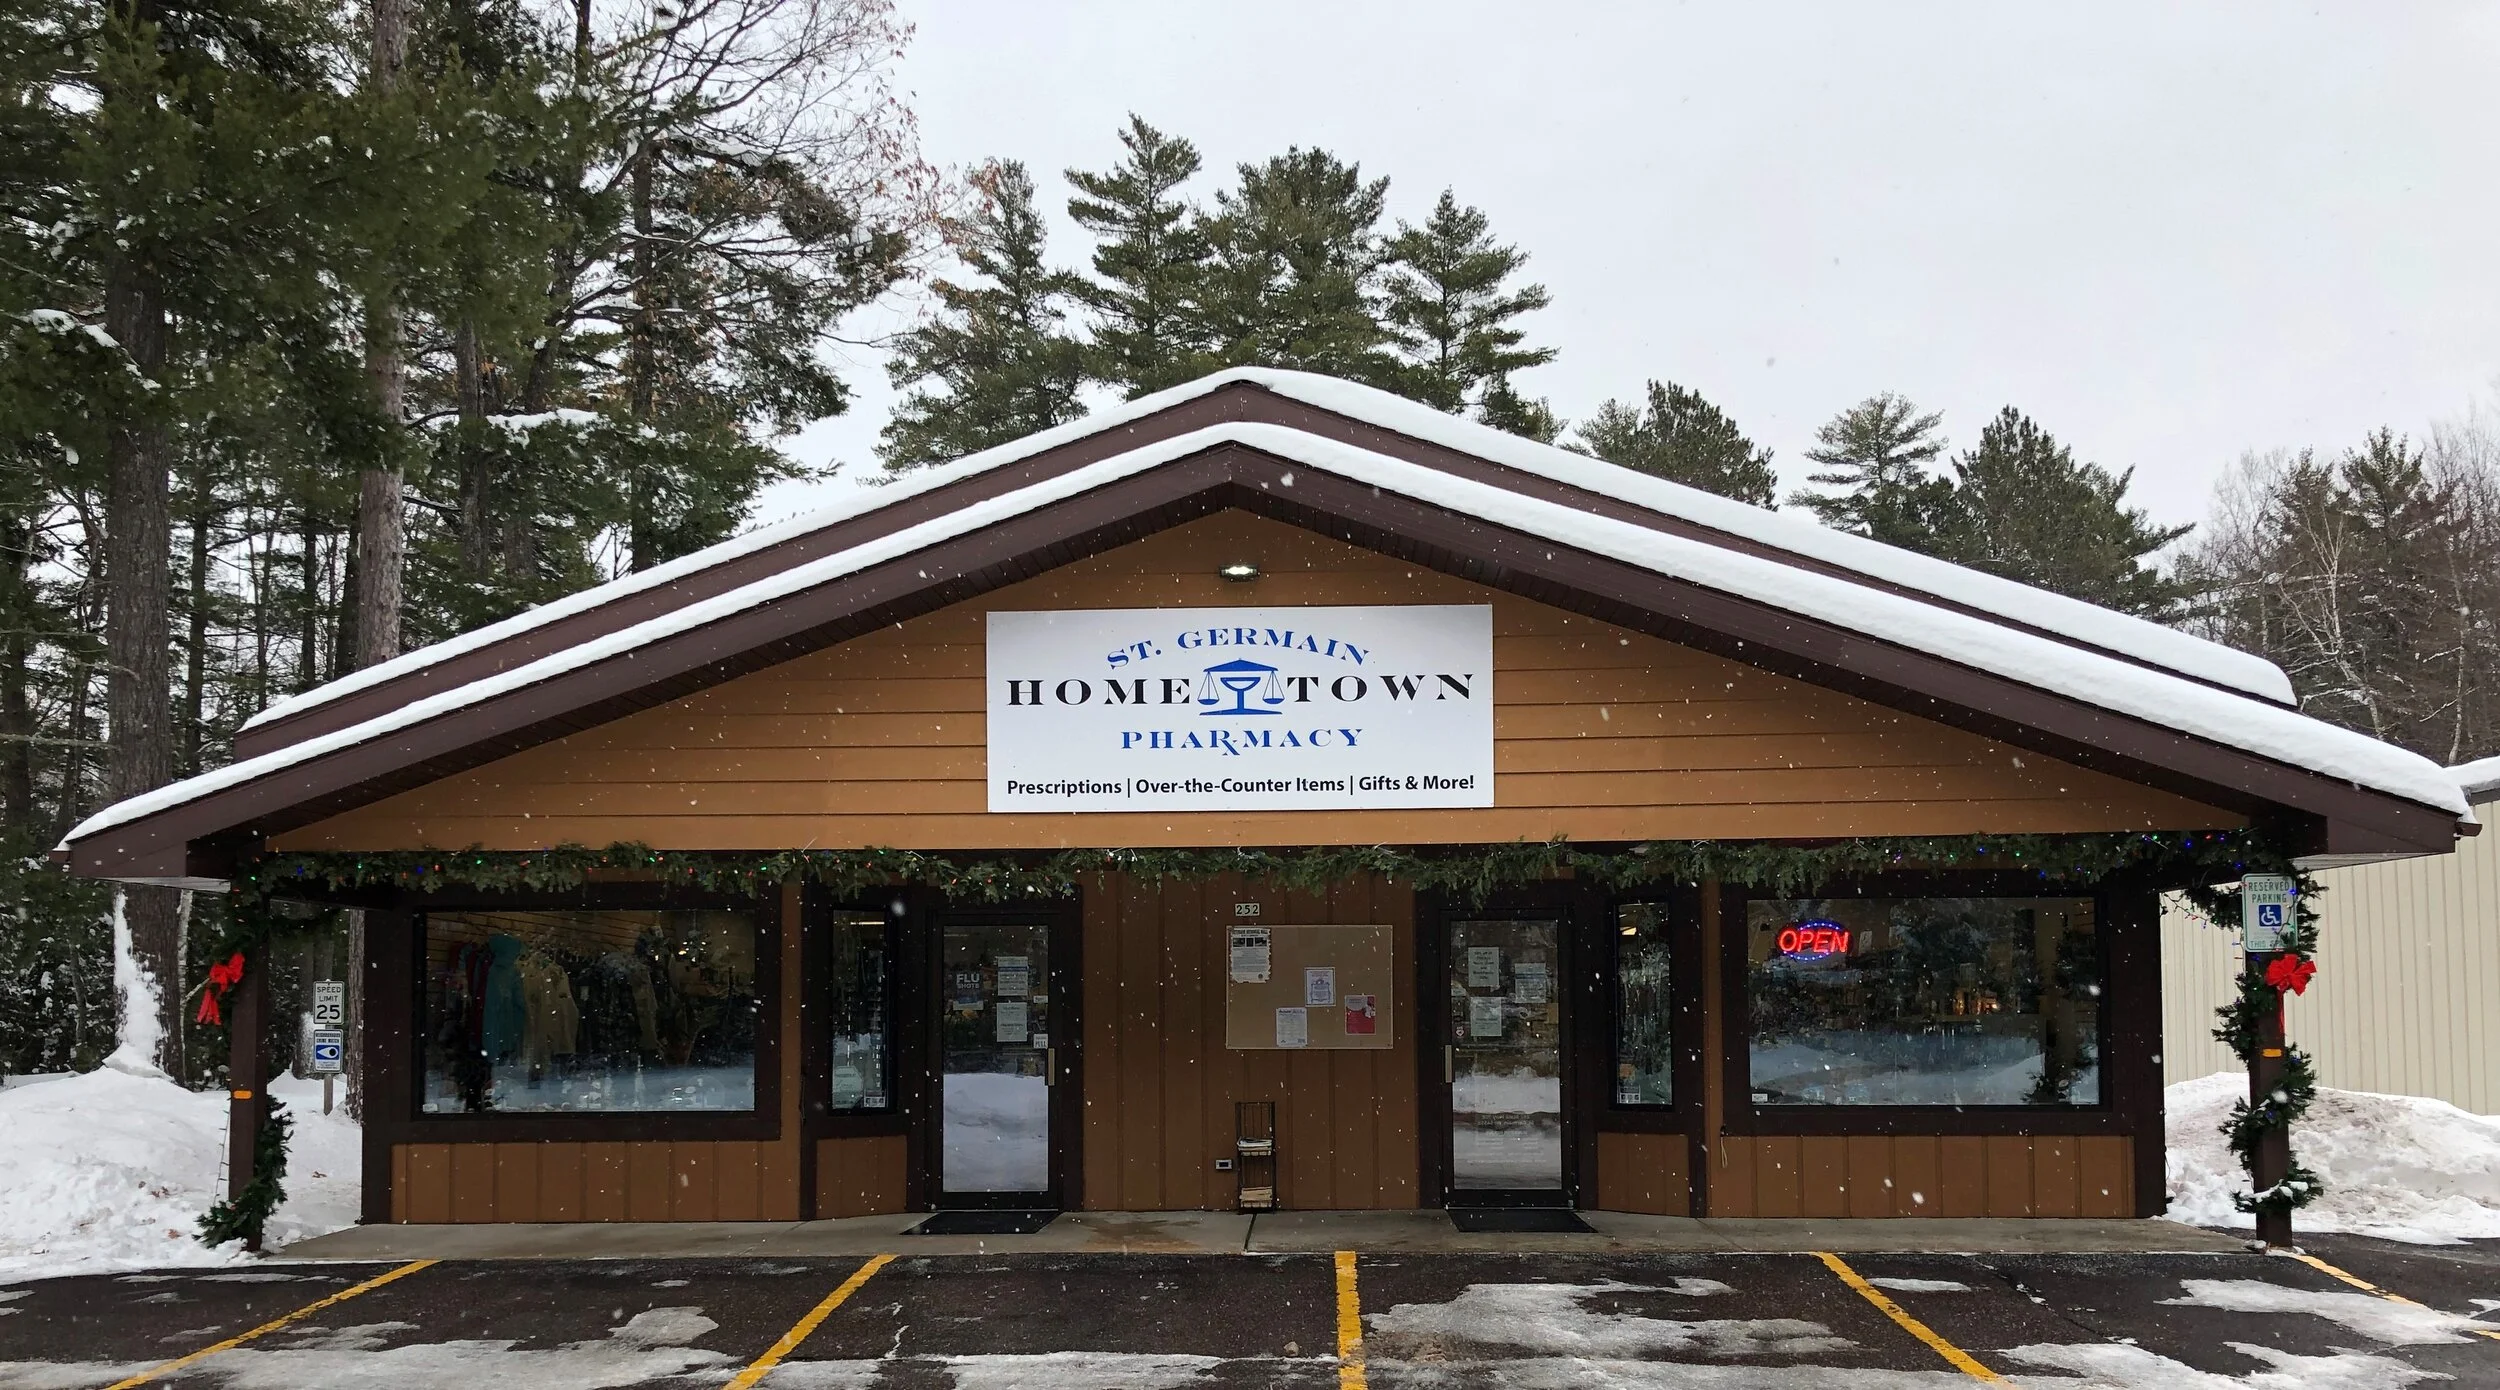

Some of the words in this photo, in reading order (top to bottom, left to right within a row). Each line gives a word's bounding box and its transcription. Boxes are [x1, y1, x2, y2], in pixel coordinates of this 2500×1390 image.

[1107, 640, 1162, 670] ST.
[1177, 627, 1371, 666] GERMAIN
[1006, 678, 1191, 706] HOME
[1286, 673, 1474, 703] TOWN
[1120, 728, 1363, 756] PHARMACY
[1007, 779, 1122, 797] Prescriptions
[1135, 777, 1291, 793] Over-the-Counter
[1296, 776, 1345, 792] Items
[1358, 775, 1401, 790] Gifts
[1405, 775, 1418, 790] &
[1423, 774, 1475, 790] More!
[2248, 881, 2290, 892] RESERVED
[2251, 893, 2287, 903] PARKING
[1236, 904, 1259, 915] 252
[1779, 930, 1849, 953] OPEN
[956, 973, 980, 983] FLU
[316, 1004, 341, 1020] 25
